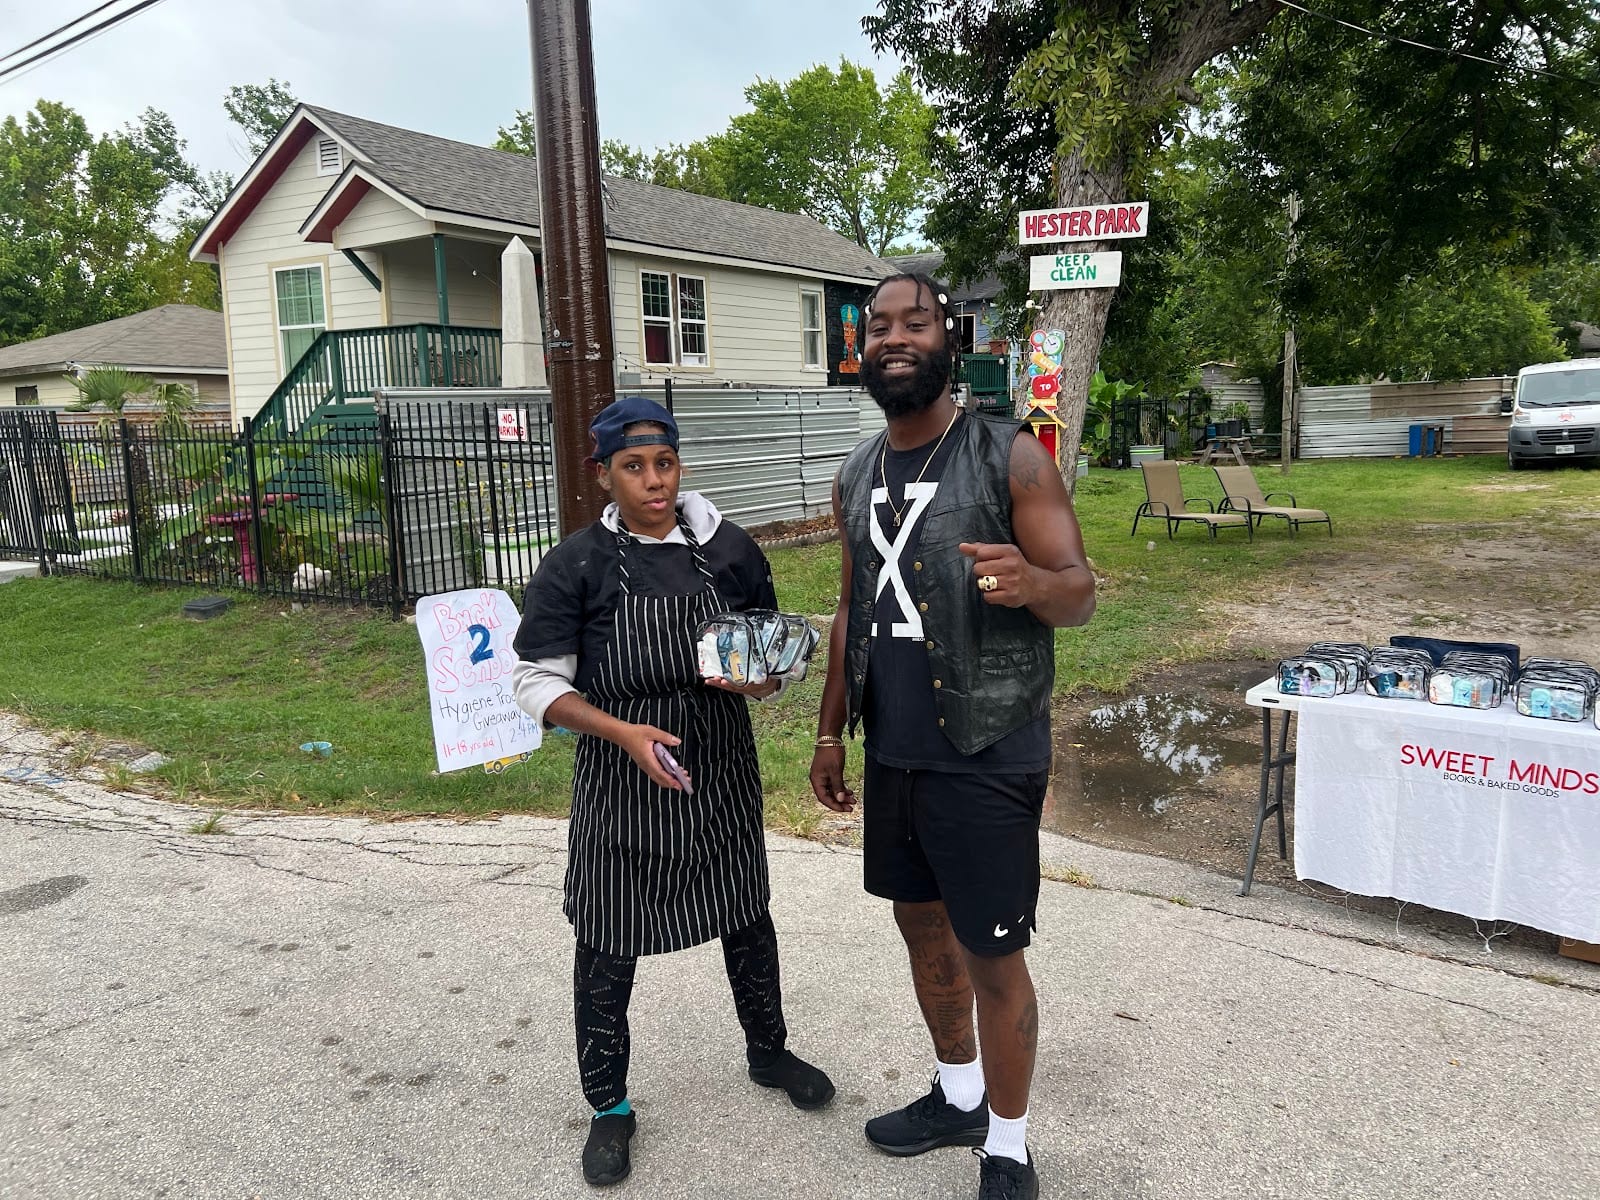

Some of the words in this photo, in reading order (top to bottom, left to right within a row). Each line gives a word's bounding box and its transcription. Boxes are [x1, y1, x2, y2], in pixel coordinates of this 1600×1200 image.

[1025, 210, 1092, 238] HESTER
[1095, 206, 1143, 236] PARK
[1055, 254, 1090, 267] KEEP
[1050, 265, 1097, 282] CLEAN
[1040, 383, 1051, 391] TO
[498, 426, 524, 437] ARKING
[467, 623, 494, 666] 2
[438, 695, 494, 724] Hygiene
[473, 707, 522, 731] Giveaway
[1400, 744, 1495, 777] SWEET
[1508, 759, 1600, 794] MINDS
[1443, 772, 1477, 785] BOOKS
[1477, 779, 1485, 787] &
[1487, 779, 1520, 791] BAKED
[1522, 784, 1560, 798] GOODS
